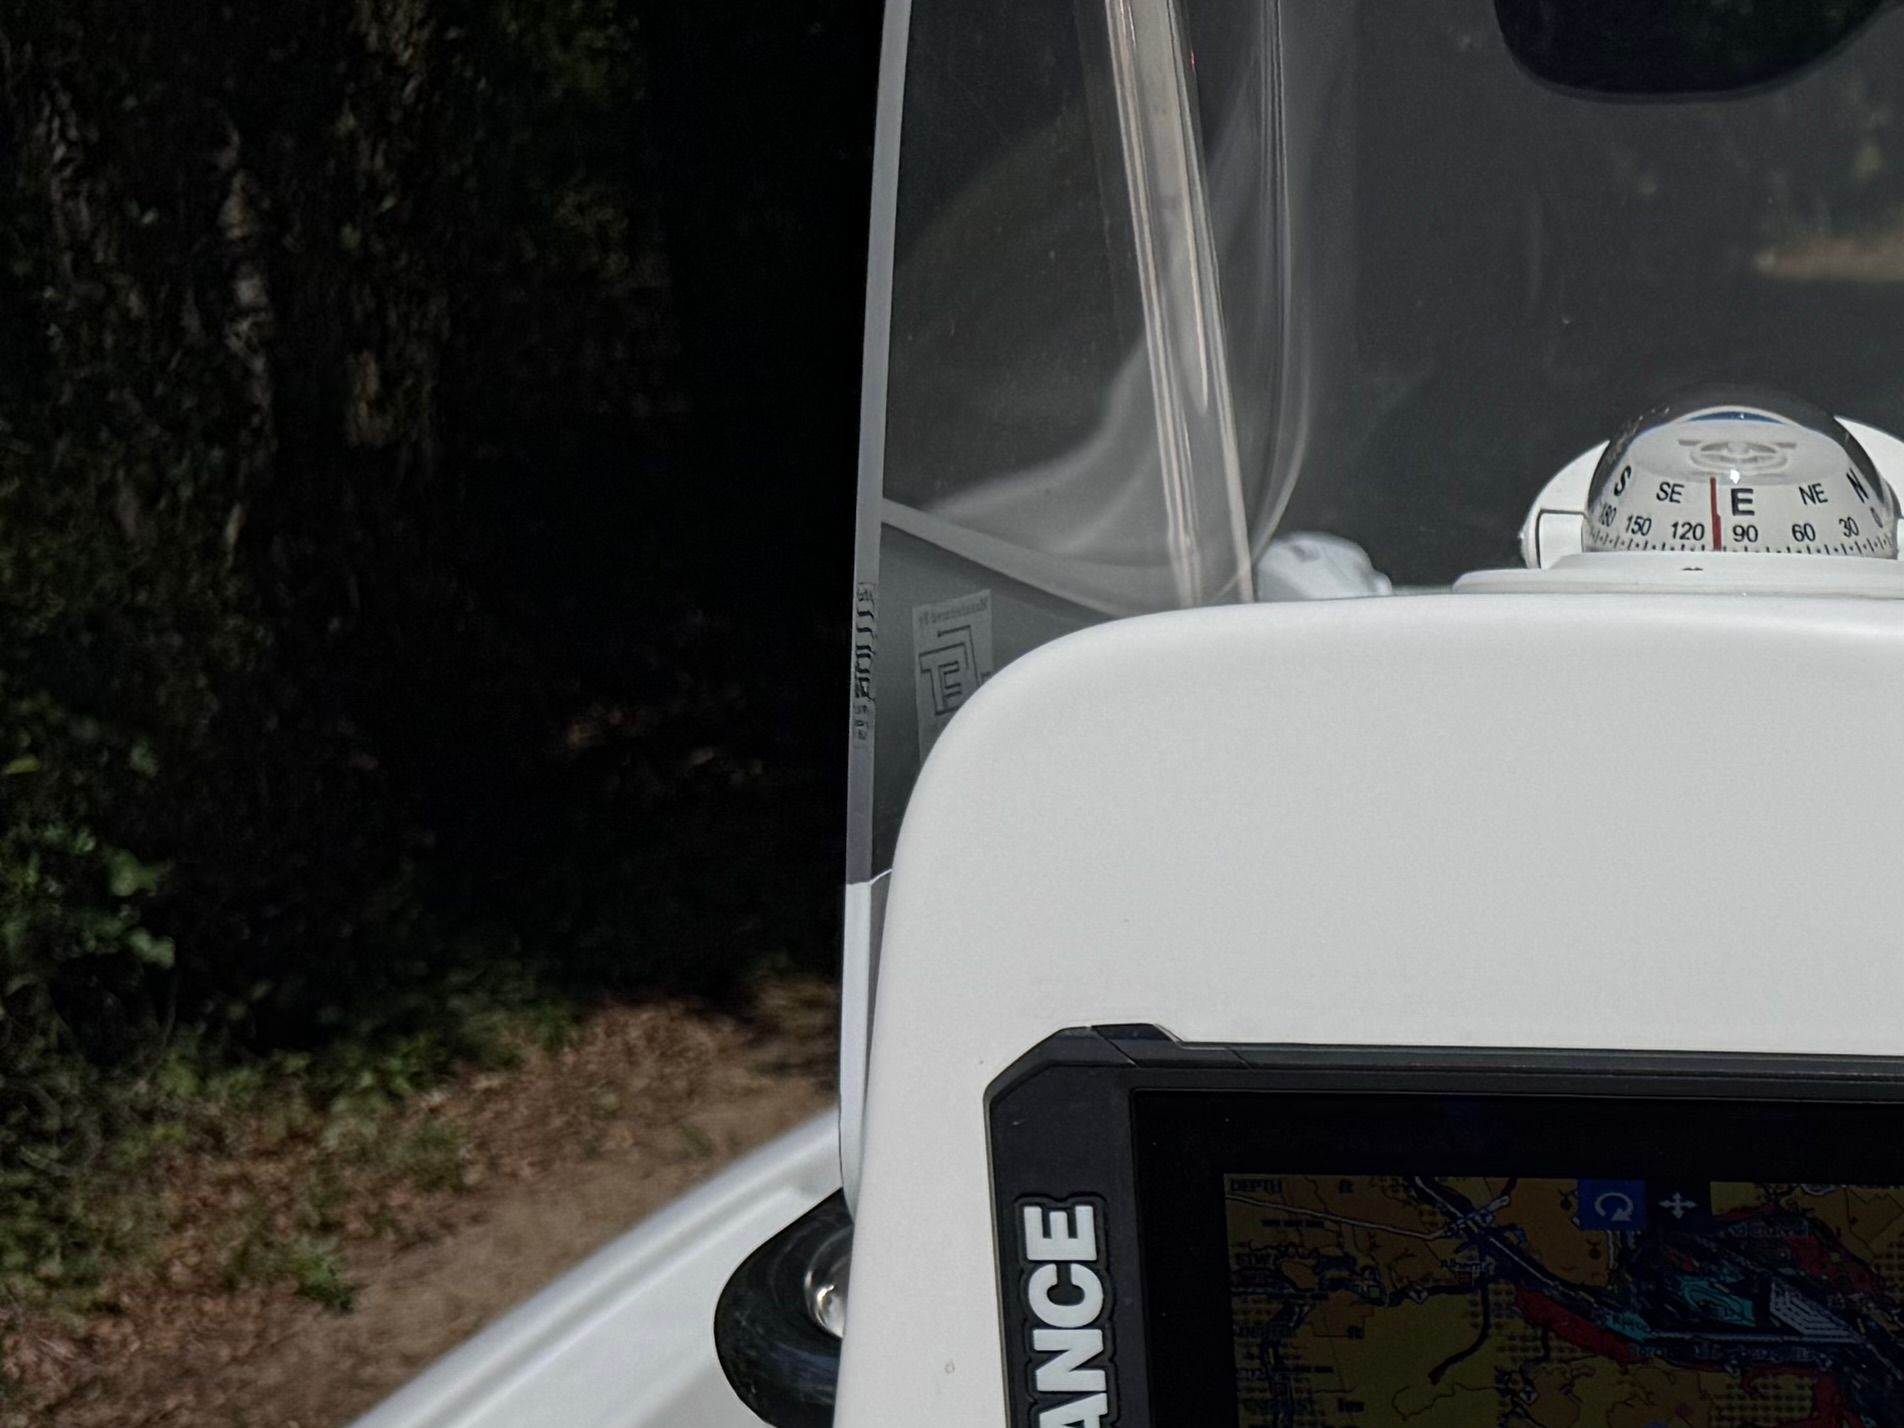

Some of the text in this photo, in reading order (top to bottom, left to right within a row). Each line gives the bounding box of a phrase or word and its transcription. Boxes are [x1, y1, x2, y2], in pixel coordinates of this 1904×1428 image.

[1614, 465, 1631, 496] S
[1656, 481, 1685, 504] SE
[1799, 483, 1829, 505] NE
[1730, 488, 1755, 516] E
[1626, 514, 1653, 537] 150
[1671, 521, 1705, 542] 120
[1733, 523, 1759, 543] 90
[1791, 521, 1817, 542] 60
[1838, 515, 1860, 538] 30
